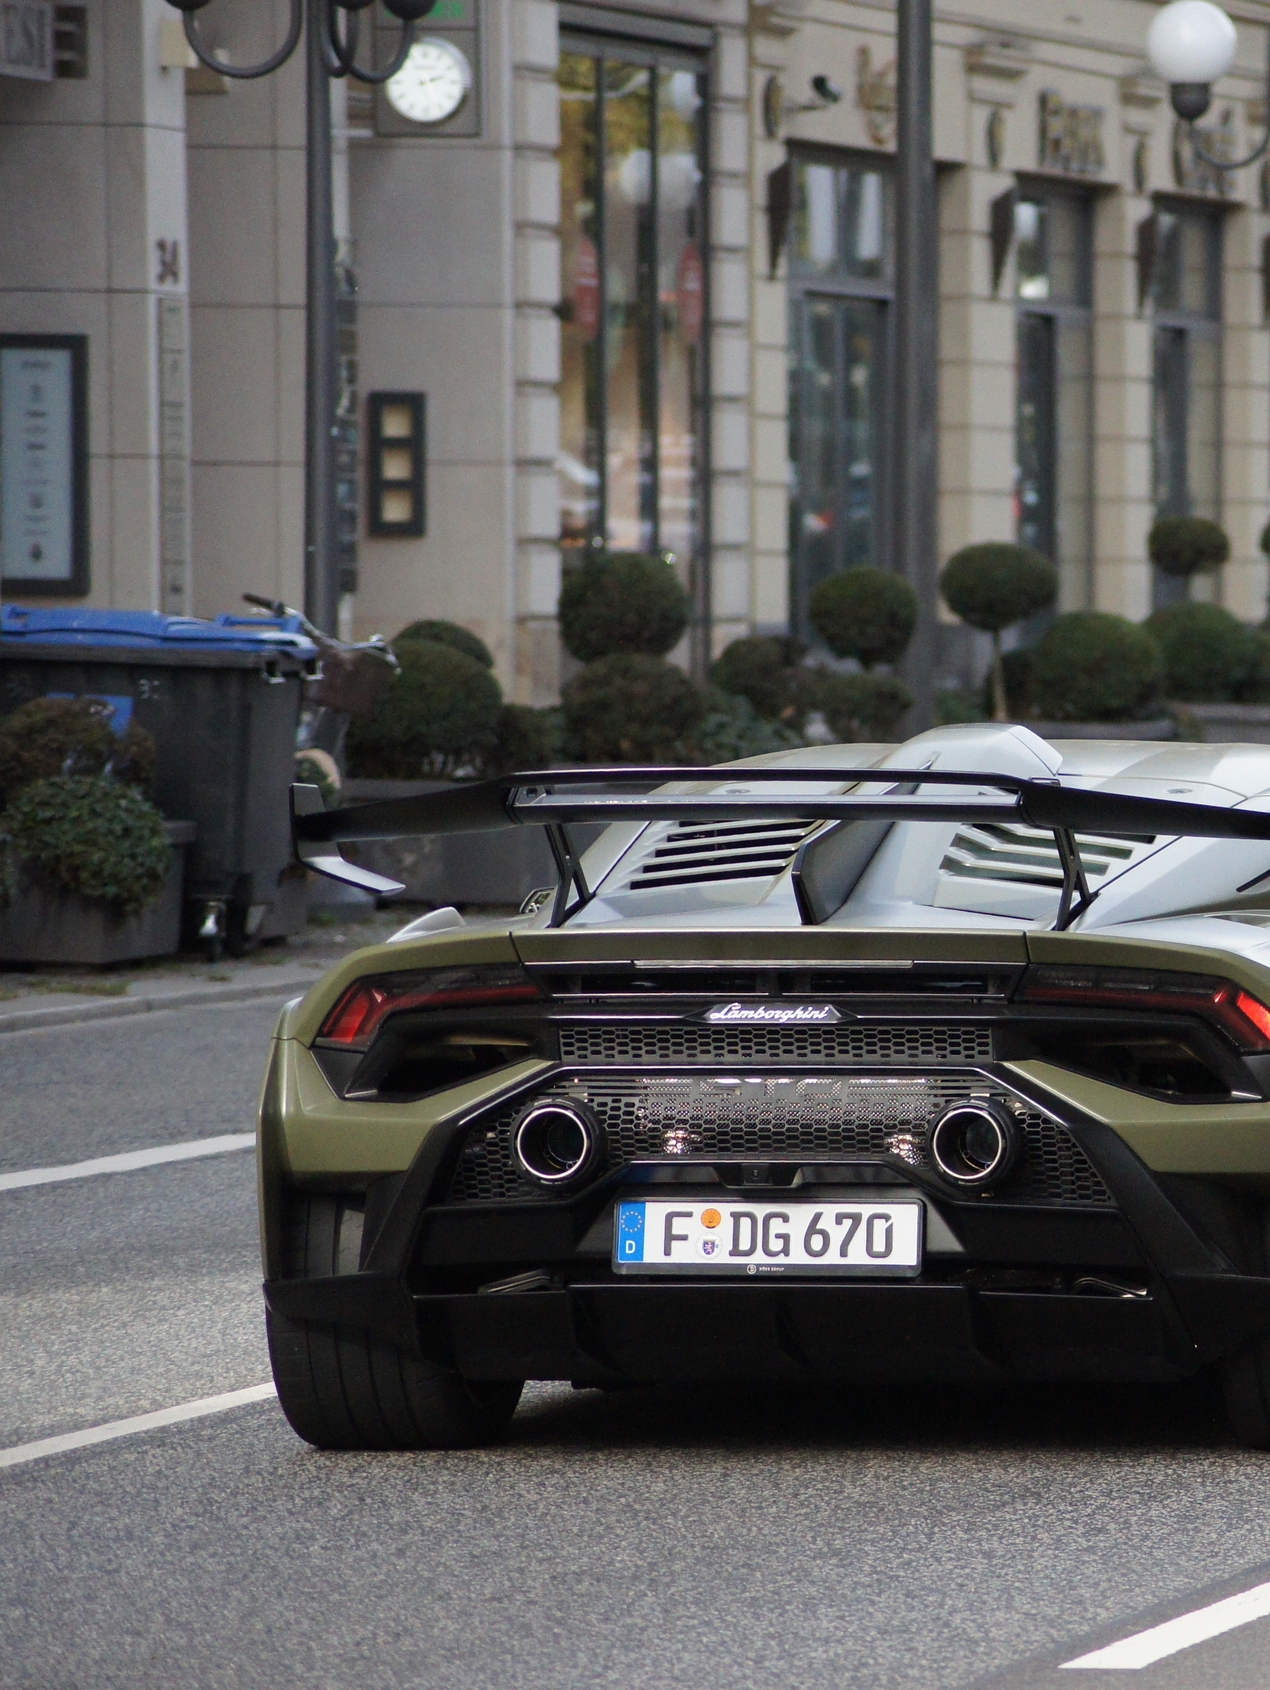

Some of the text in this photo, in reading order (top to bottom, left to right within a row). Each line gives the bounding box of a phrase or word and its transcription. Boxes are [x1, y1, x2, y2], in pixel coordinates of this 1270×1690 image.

[709, 1002, 830, 1023] Lamborghini
[663, 1210, 894, 1259] F DG 670
[625, 1240, 636, 1254] D
